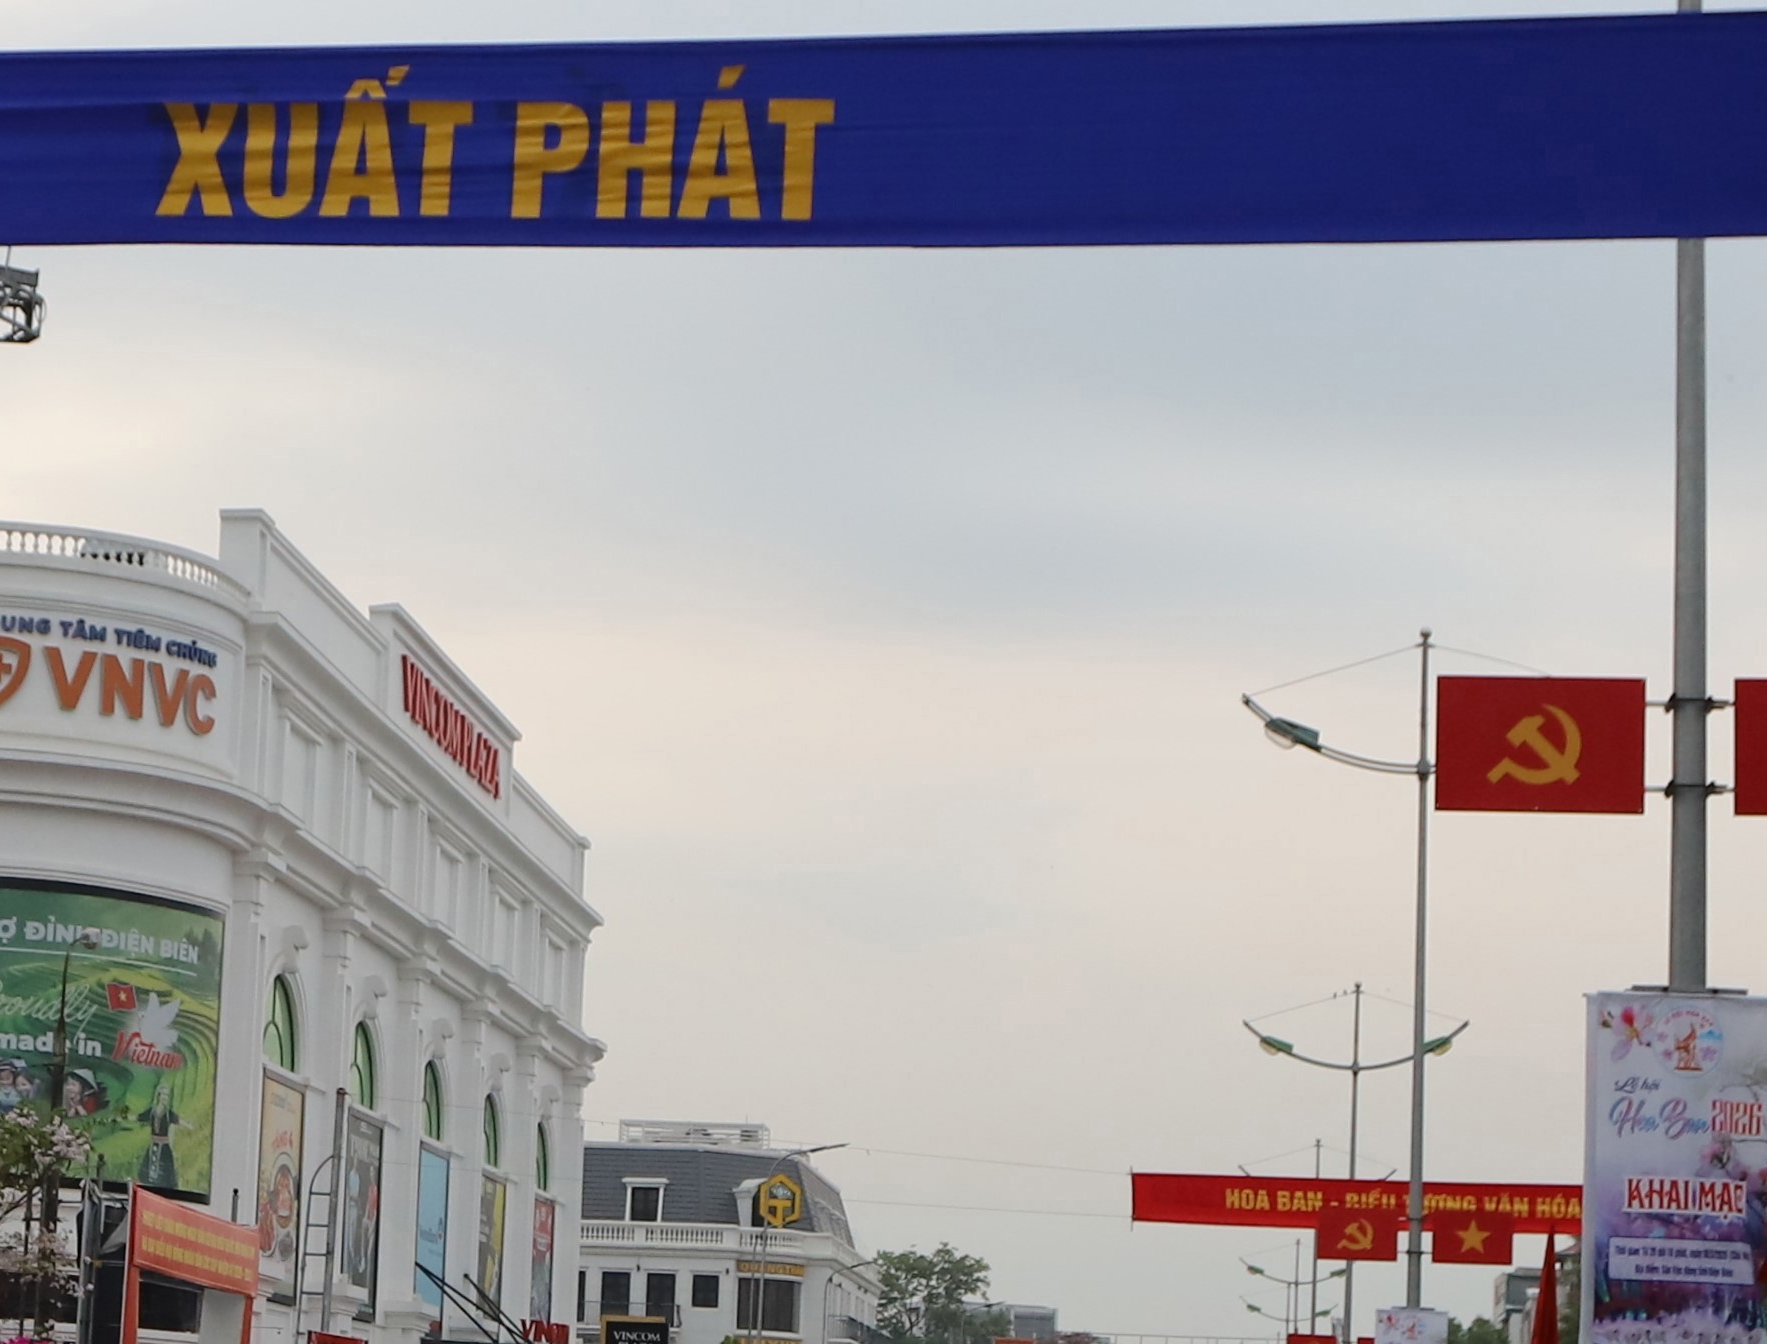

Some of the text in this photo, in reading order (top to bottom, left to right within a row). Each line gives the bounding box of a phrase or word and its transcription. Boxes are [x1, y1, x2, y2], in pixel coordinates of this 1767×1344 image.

[155, 64, 836, 221] XUẤT PHÁT
[59, 619, 106, 642] TÂM
[114, 628, 161, 653] TIÊM
[165, 639, 218, 668] CHỦNG
[43, 645, 217, 736] VNVC
[159, 938, 199, 964] BIÊN
[77, 1032, 102, 1057] in
[112, 1031, 186, 1069] Vietnam
[1711, 1100, 1763, 1136] 2026
[1225, 1188, 1270, 1211] HOA
[1276, 1190, 1323, 1212] BAN
[1536, 1194, 1582, 1220] HÓA
[1626, 1178, 1745, 1220] KHAI MẠC
[613, 1331, 661, 1342] VINCOM
